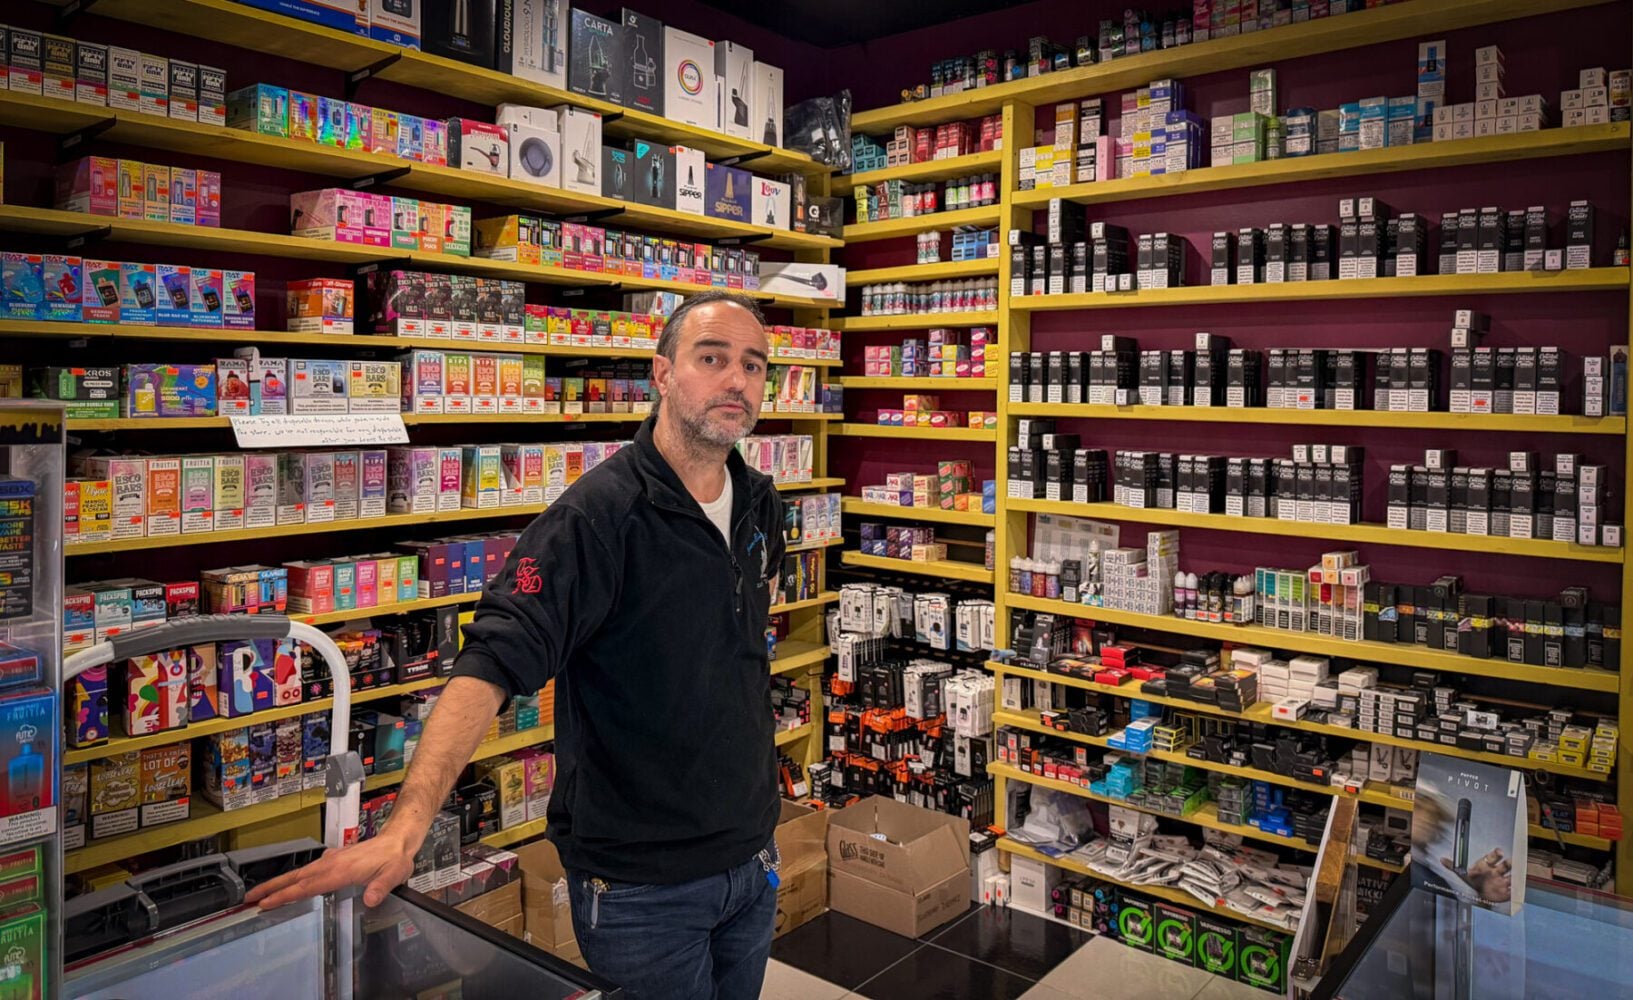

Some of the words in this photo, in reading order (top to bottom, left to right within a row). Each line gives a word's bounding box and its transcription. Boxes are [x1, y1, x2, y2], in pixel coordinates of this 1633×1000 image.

[584, 17, 613, 36] CARTA
[714, 202, 743, 217] SIPPER
[312, 368, 331, 376] ESCO
[365, 366, 386, 374] ESCO
[365, 374, 386, 383] BARS
[311, 464, 331, 474] ESCO
[416, 460, 434, 469] ESCO
[221, 469, 240, 478] ESCO
[251, 466, 273, 476] ESCO
[417, 468, 435, 477] BARS
[115, 473, 141, 484] ESCO
[221, 477, 240, 486] BARS
[251, 475, 273, 485] BARS
[312, 473, 332, 483] BARS
[116, 483, 143, 495] BARS
[136, 587, 163, 598] PACKSPOD
[170, 585, 195, 596] PACKSPOD
[7, 707, 45, 722] FRUITIA
[144, 759, 163, 771] LOT
[164, 757, 176, 767] OF
[1448, 776, 1489, 793] PIVOT
